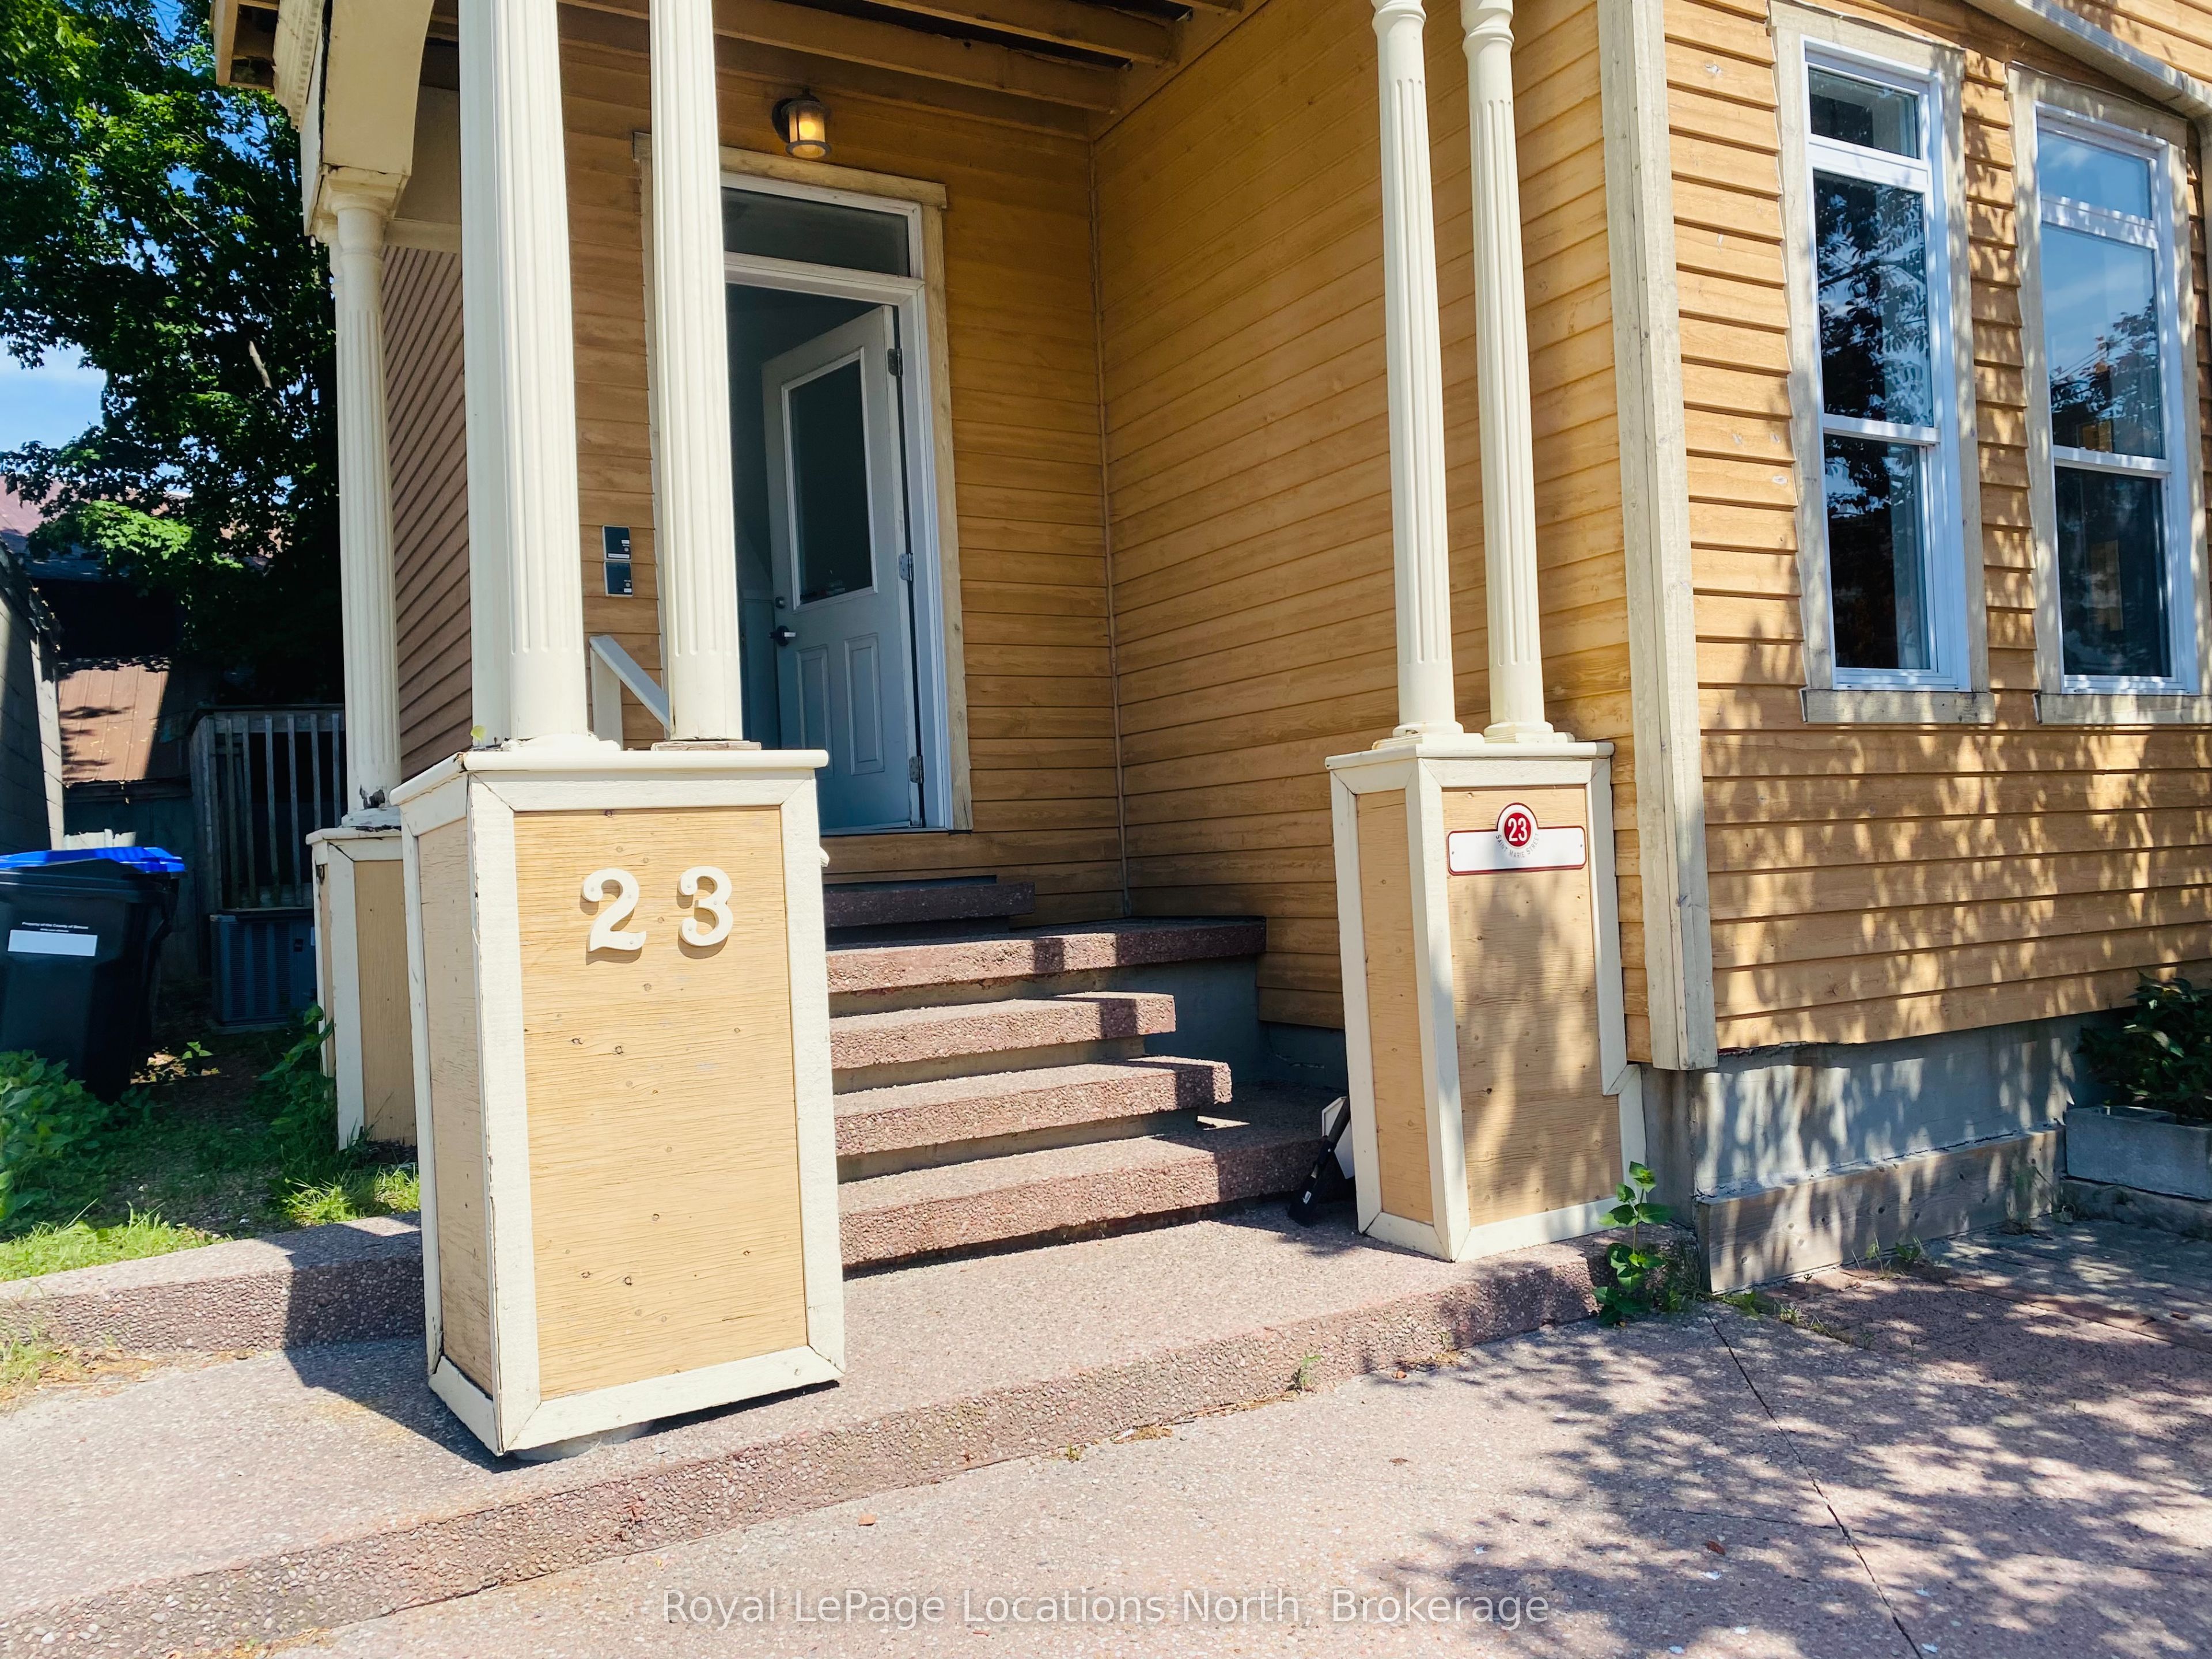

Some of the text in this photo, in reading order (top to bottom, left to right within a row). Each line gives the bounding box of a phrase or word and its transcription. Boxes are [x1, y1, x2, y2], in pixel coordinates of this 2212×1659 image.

[1508, 817, 1528, 842] 23
[1495, 833, 1539, 858] SAINT MARIE STREET
